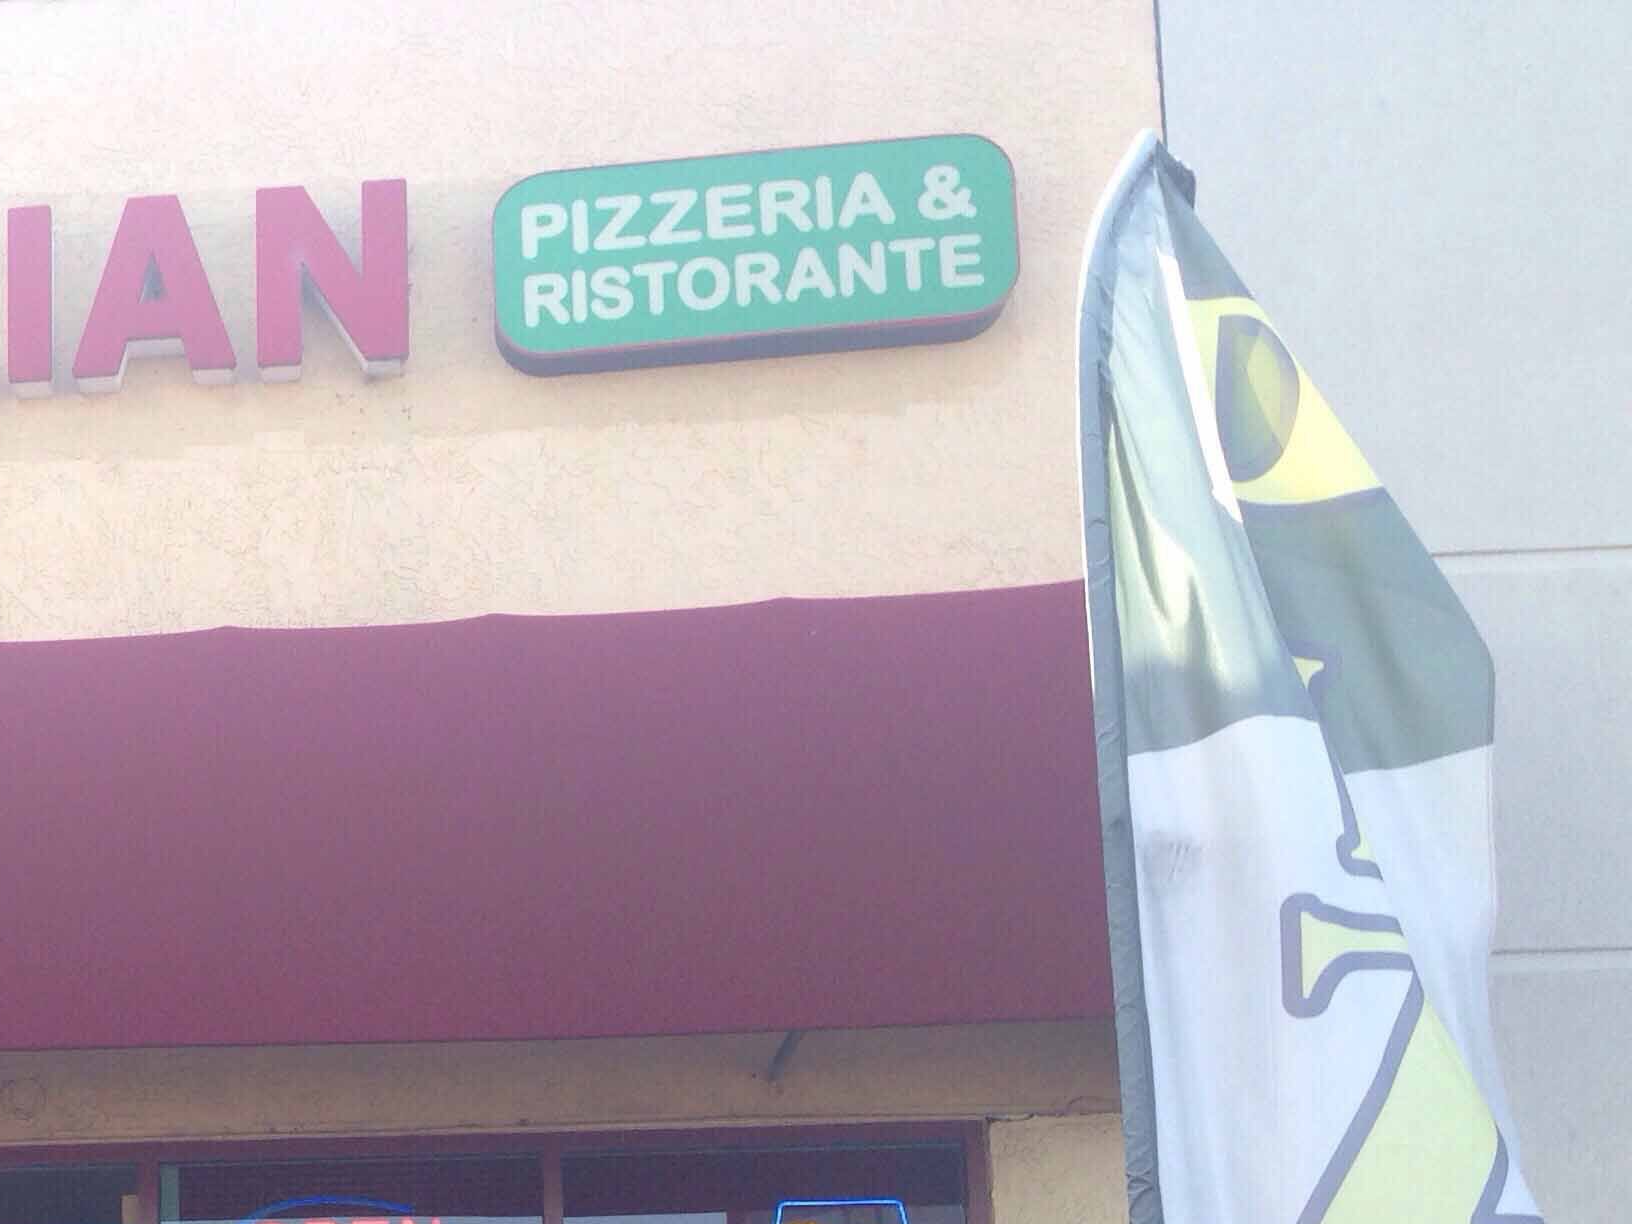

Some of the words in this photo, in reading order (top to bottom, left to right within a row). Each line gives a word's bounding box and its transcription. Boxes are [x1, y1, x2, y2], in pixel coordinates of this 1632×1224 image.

[520, 171, 896, 260] PIZZERIA
[917, 164, 977, 221] &
[523, 234, 986, 328] RISTORANTE
